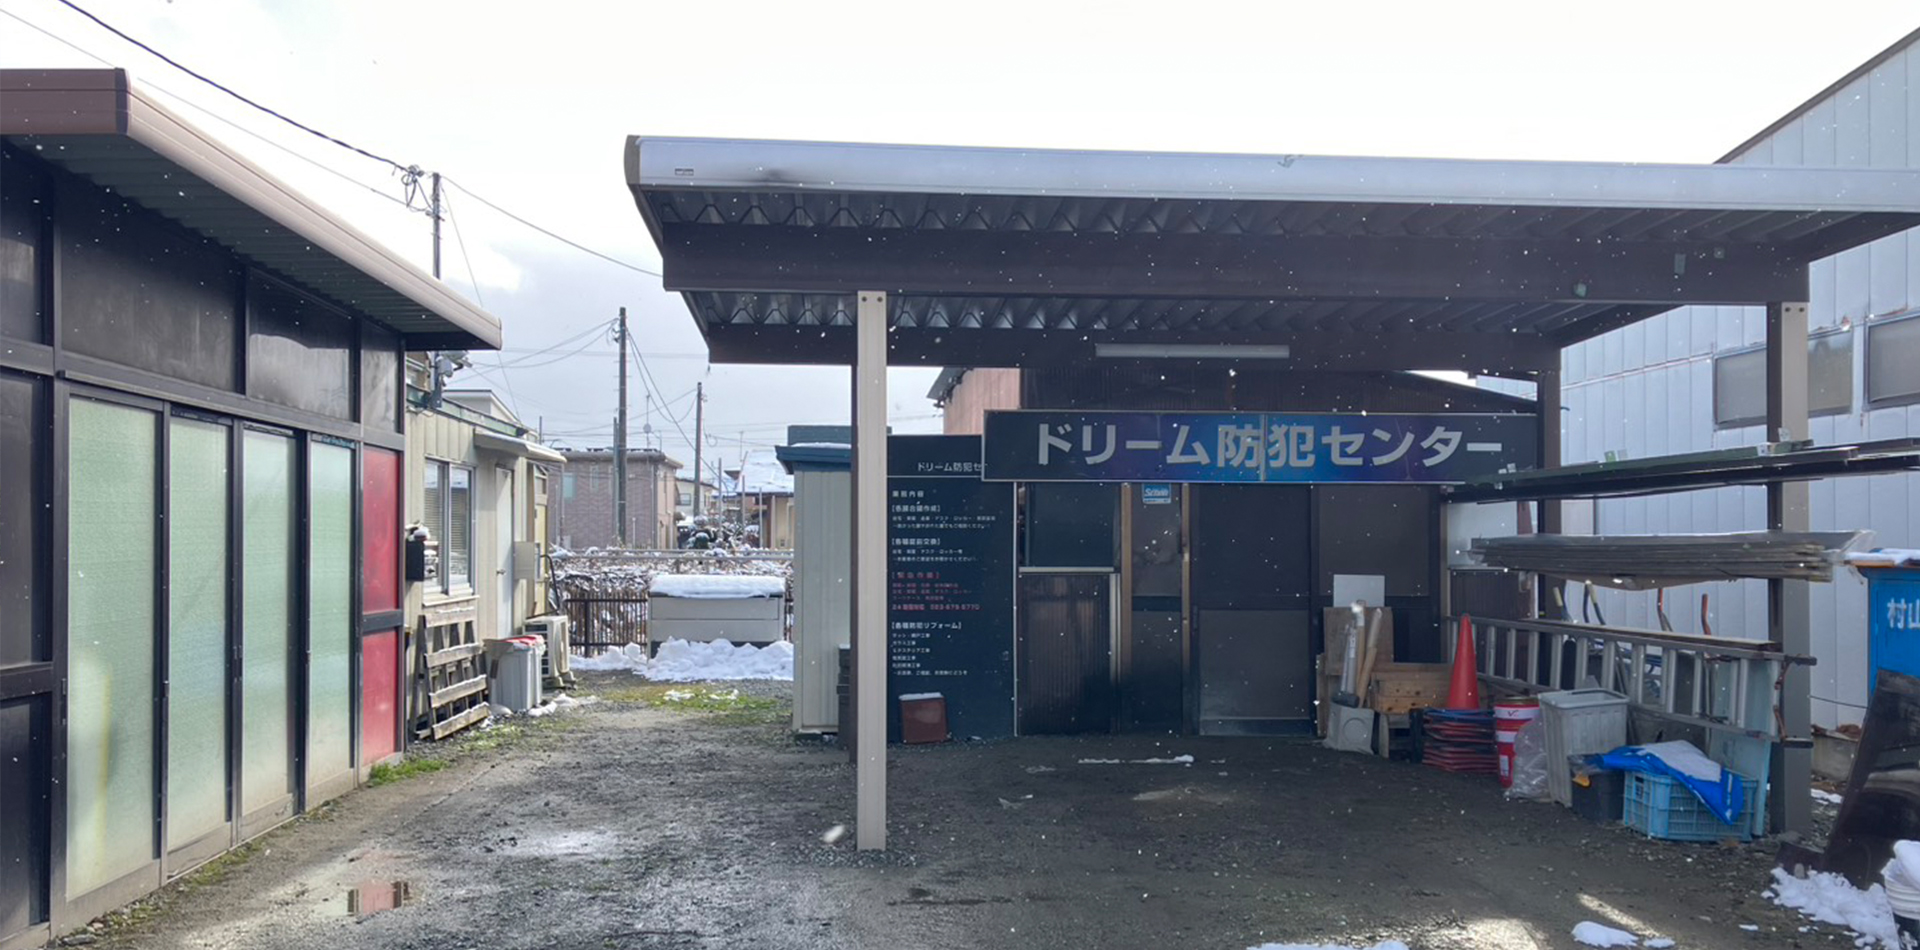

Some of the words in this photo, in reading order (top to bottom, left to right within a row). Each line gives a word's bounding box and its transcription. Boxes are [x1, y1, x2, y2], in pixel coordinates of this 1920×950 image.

[1038, 423, 1503, 468] ドリーム防犯センター
